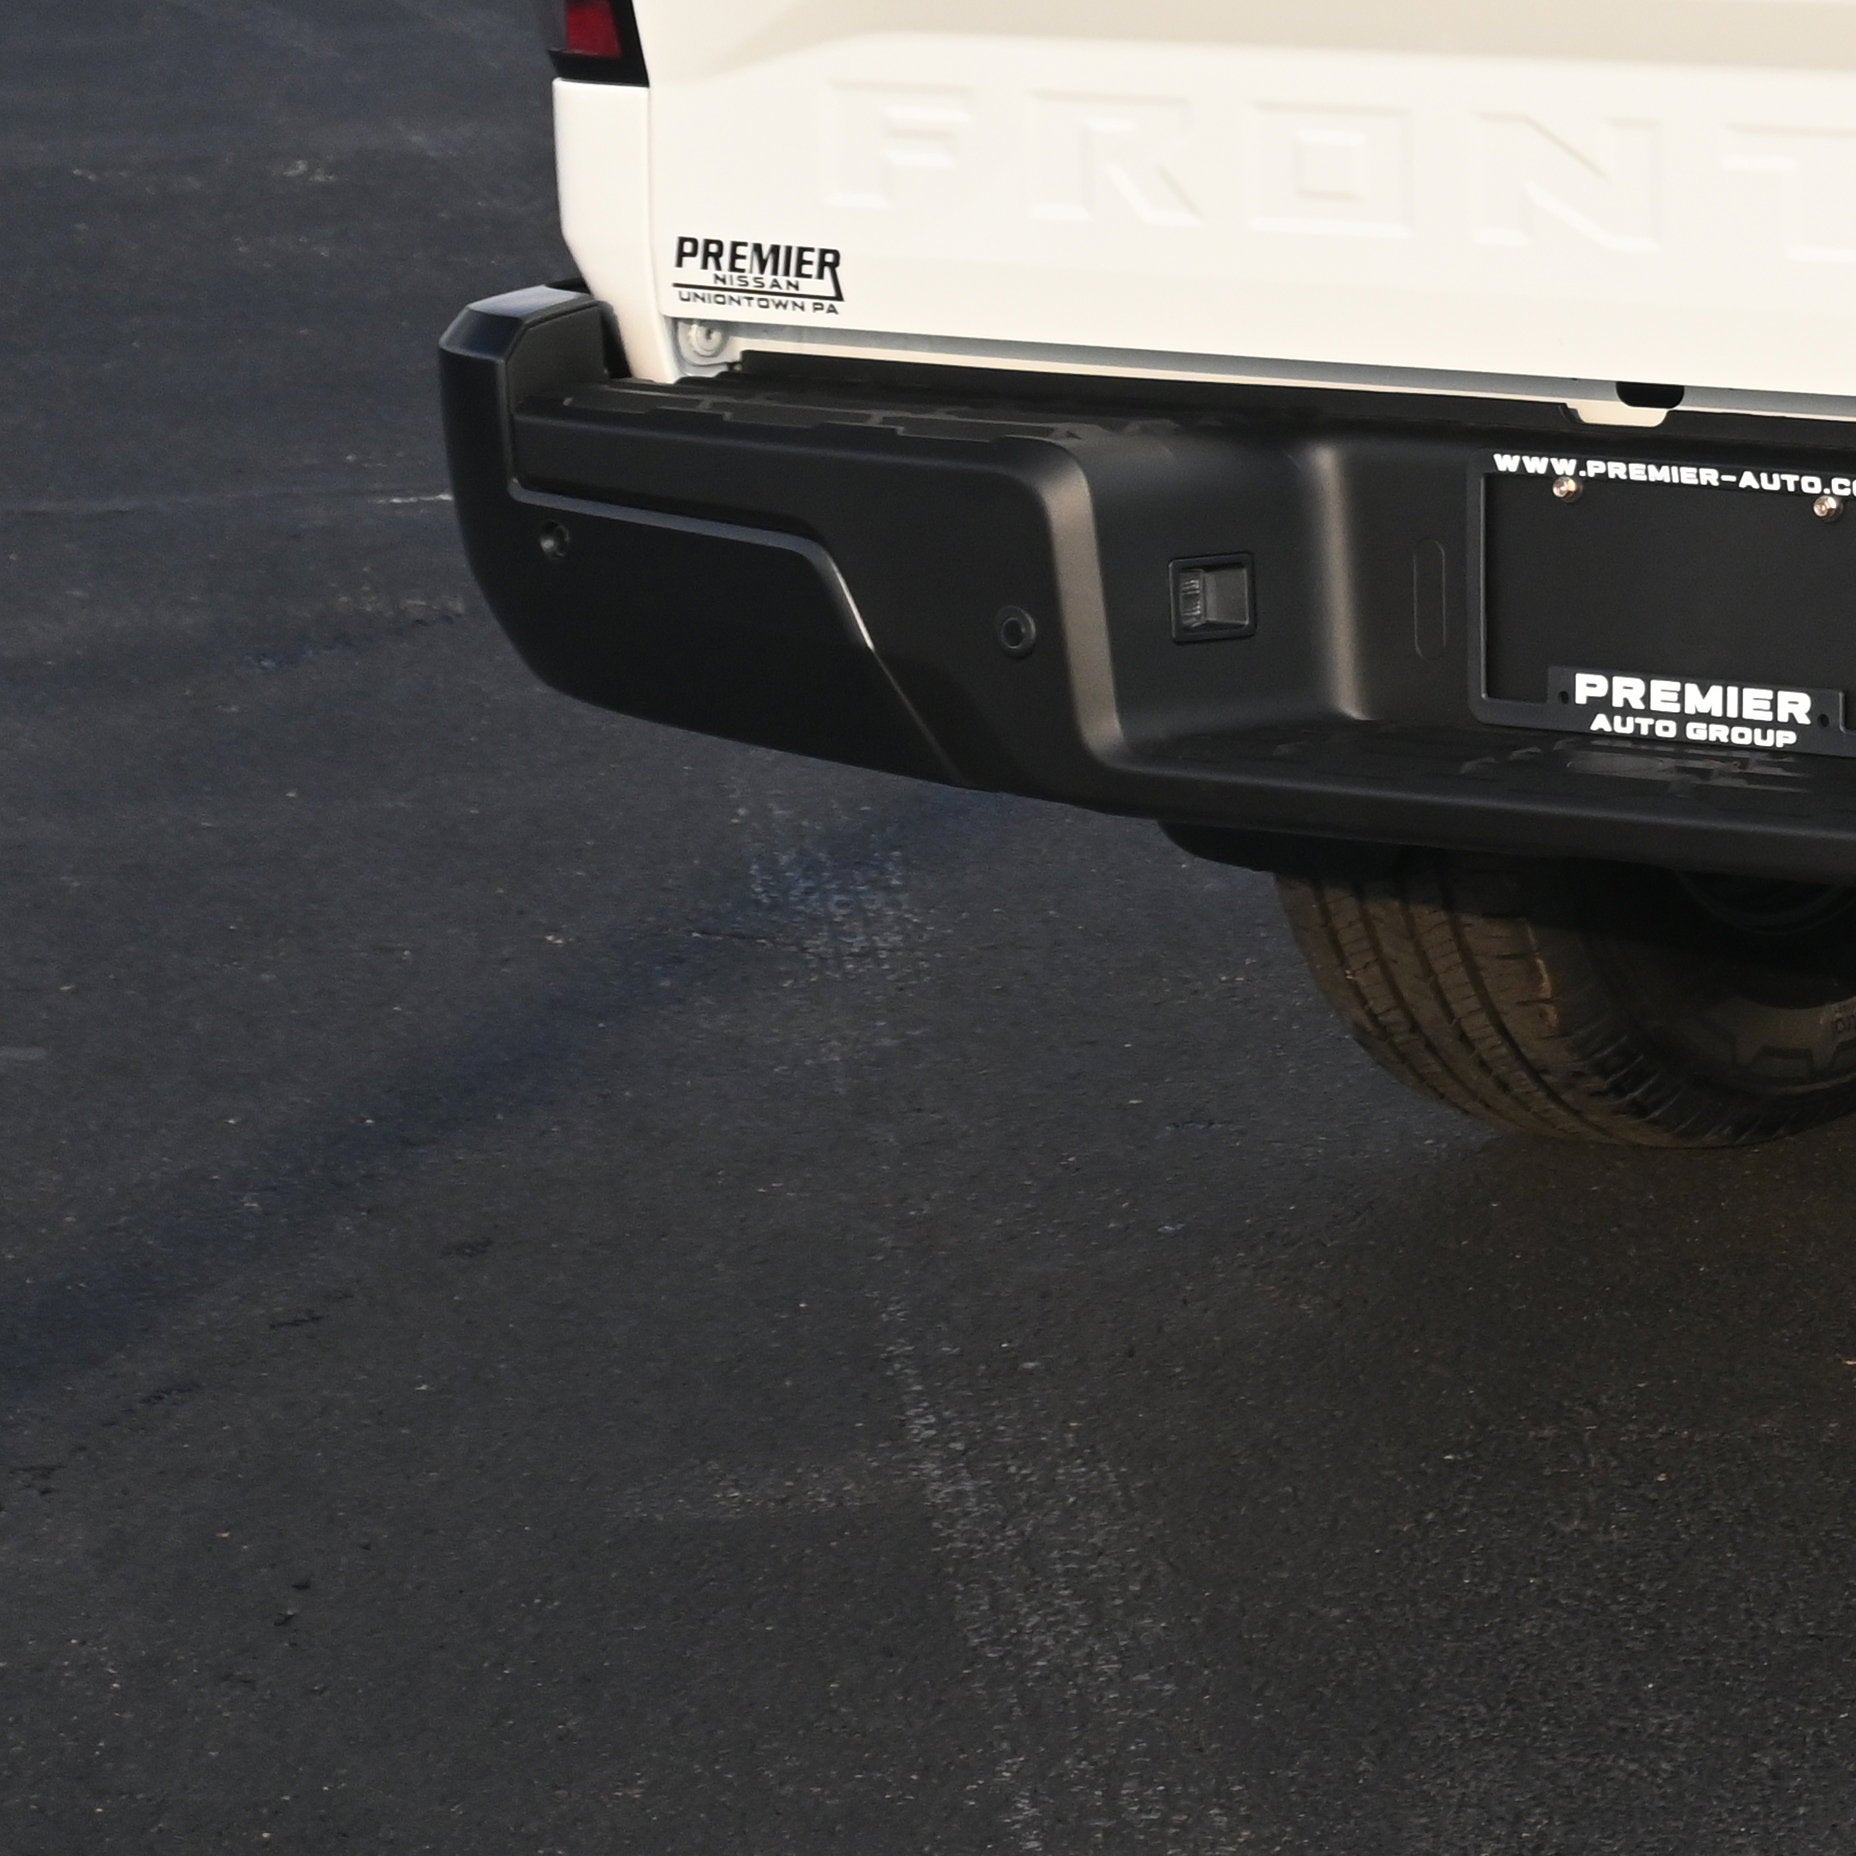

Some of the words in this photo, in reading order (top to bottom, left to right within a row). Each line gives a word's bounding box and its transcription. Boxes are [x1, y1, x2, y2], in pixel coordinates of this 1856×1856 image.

[674, 235, 843, 281] PREMIER
[713, 273, 800, 292] NISSAN
[678, 290, 806, 313] UNIONTOWN
[812, 301, 839, 315] PA
[1574, 672, 1811, 725] PREMIER
[1589, 713, 1677, 739] AUTO
[1686, 722, 1798, 749] GROUP
